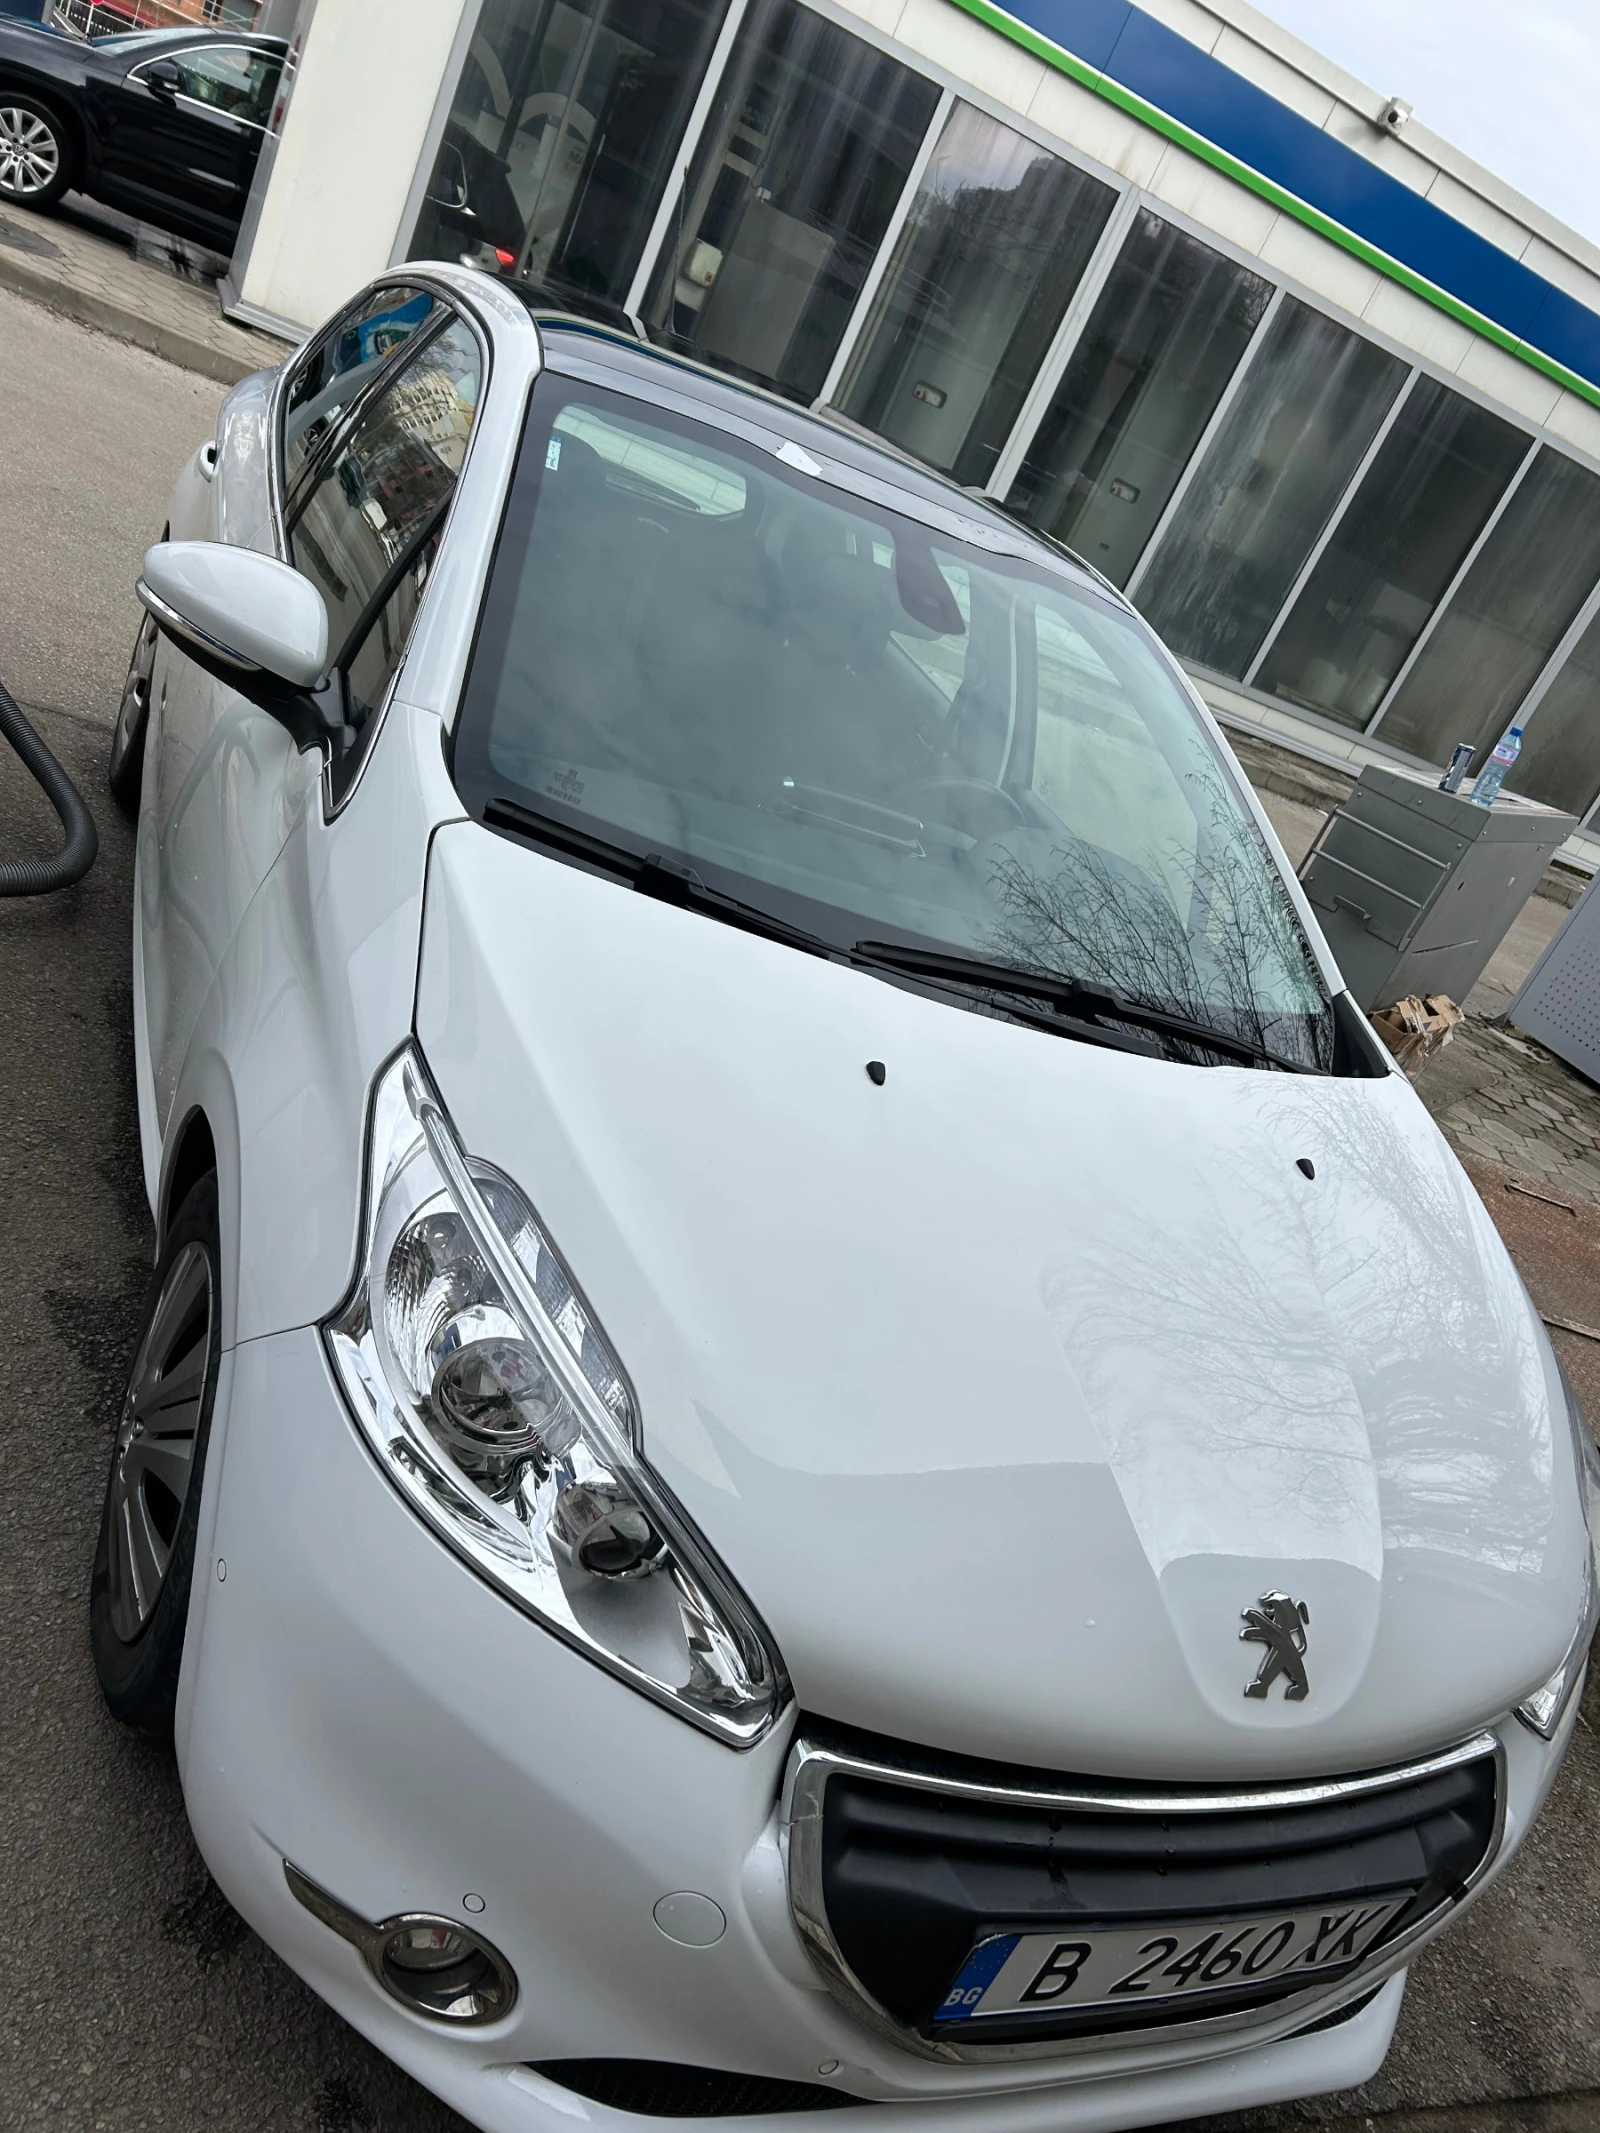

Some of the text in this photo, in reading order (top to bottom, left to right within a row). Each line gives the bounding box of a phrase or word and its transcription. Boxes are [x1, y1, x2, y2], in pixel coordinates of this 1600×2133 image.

[1018, 1904, 1391, 2003] B 2460 XK
[943, 1986, 983, 2007] BG
